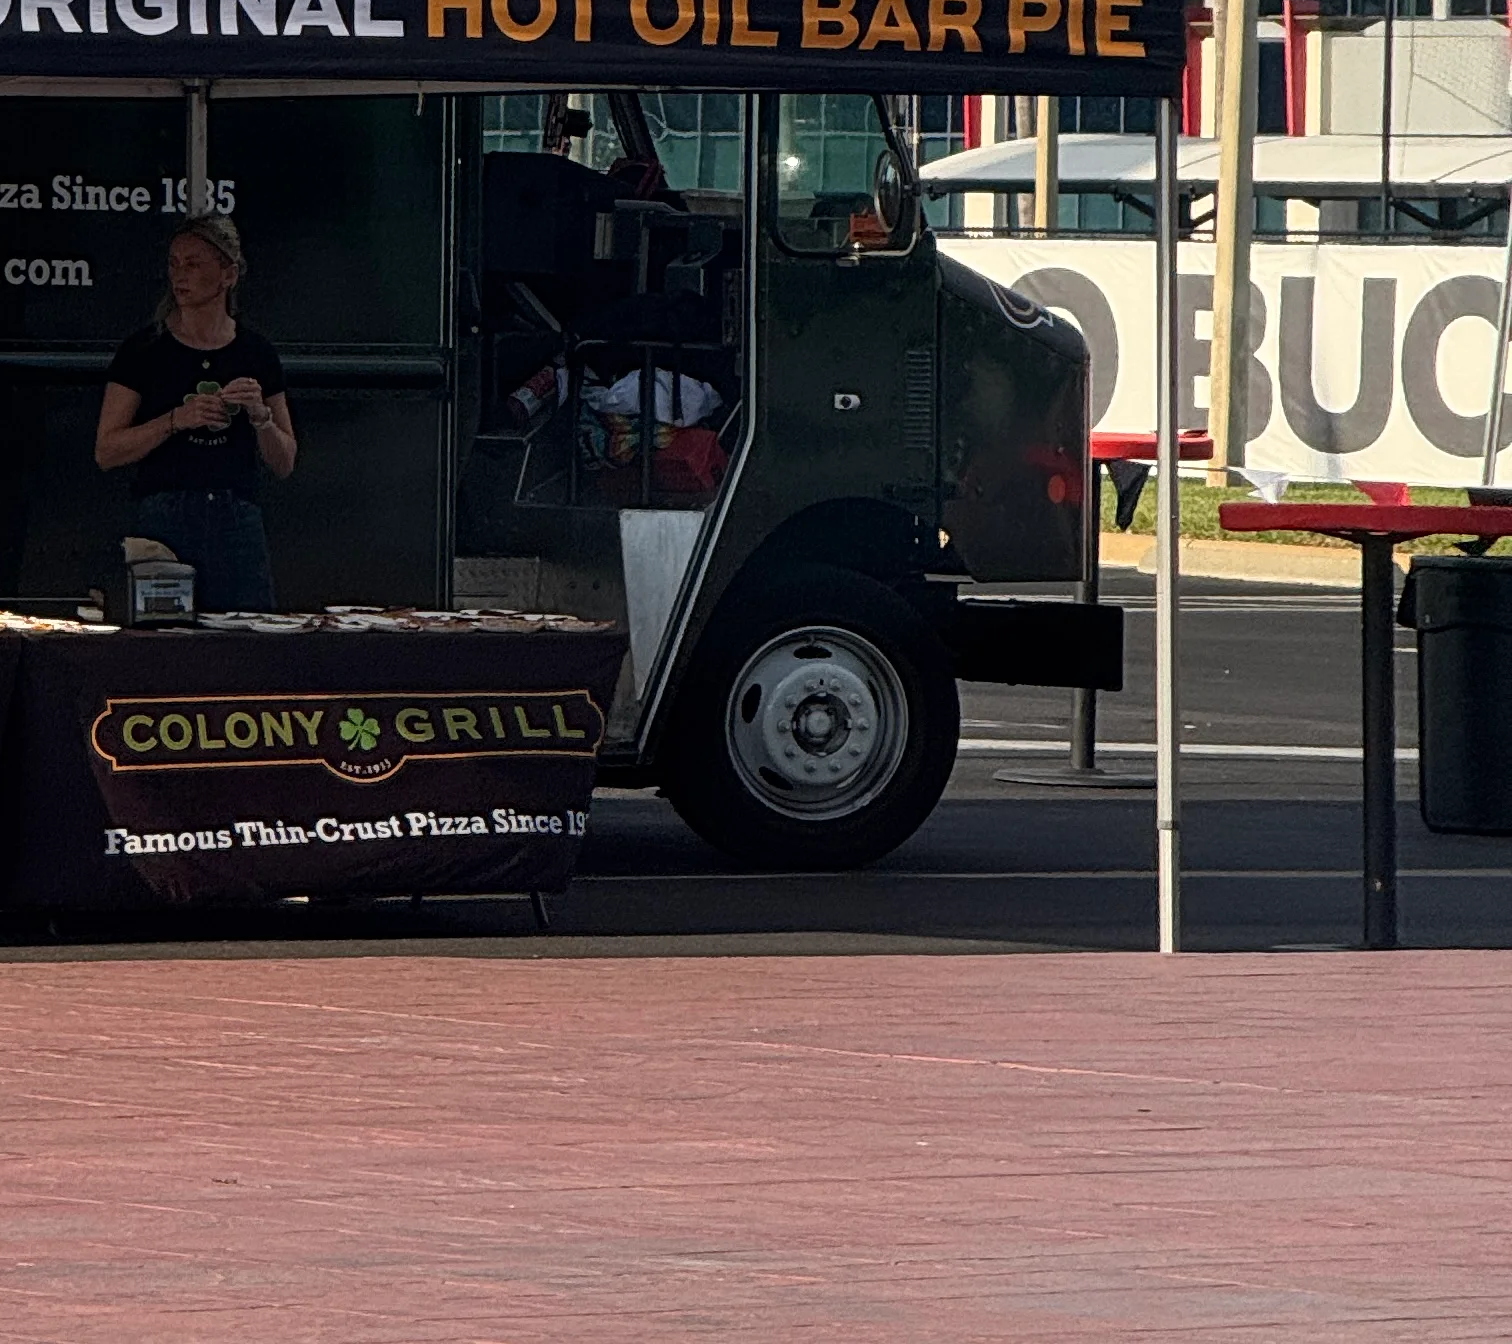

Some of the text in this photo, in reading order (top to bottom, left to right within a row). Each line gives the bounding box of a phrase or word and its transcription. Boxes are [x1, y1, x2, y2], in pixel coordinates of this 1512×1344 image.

[52, 175, 150, 212] Since
[122, 703, 586, 752] COLONY GRILL
[105, 825, 233, 855] Famous
[236, 814, 404, 847] Thin-Crust
[405, 812, 489, 836] Pizza
[492, 809, 562, 833] Since
